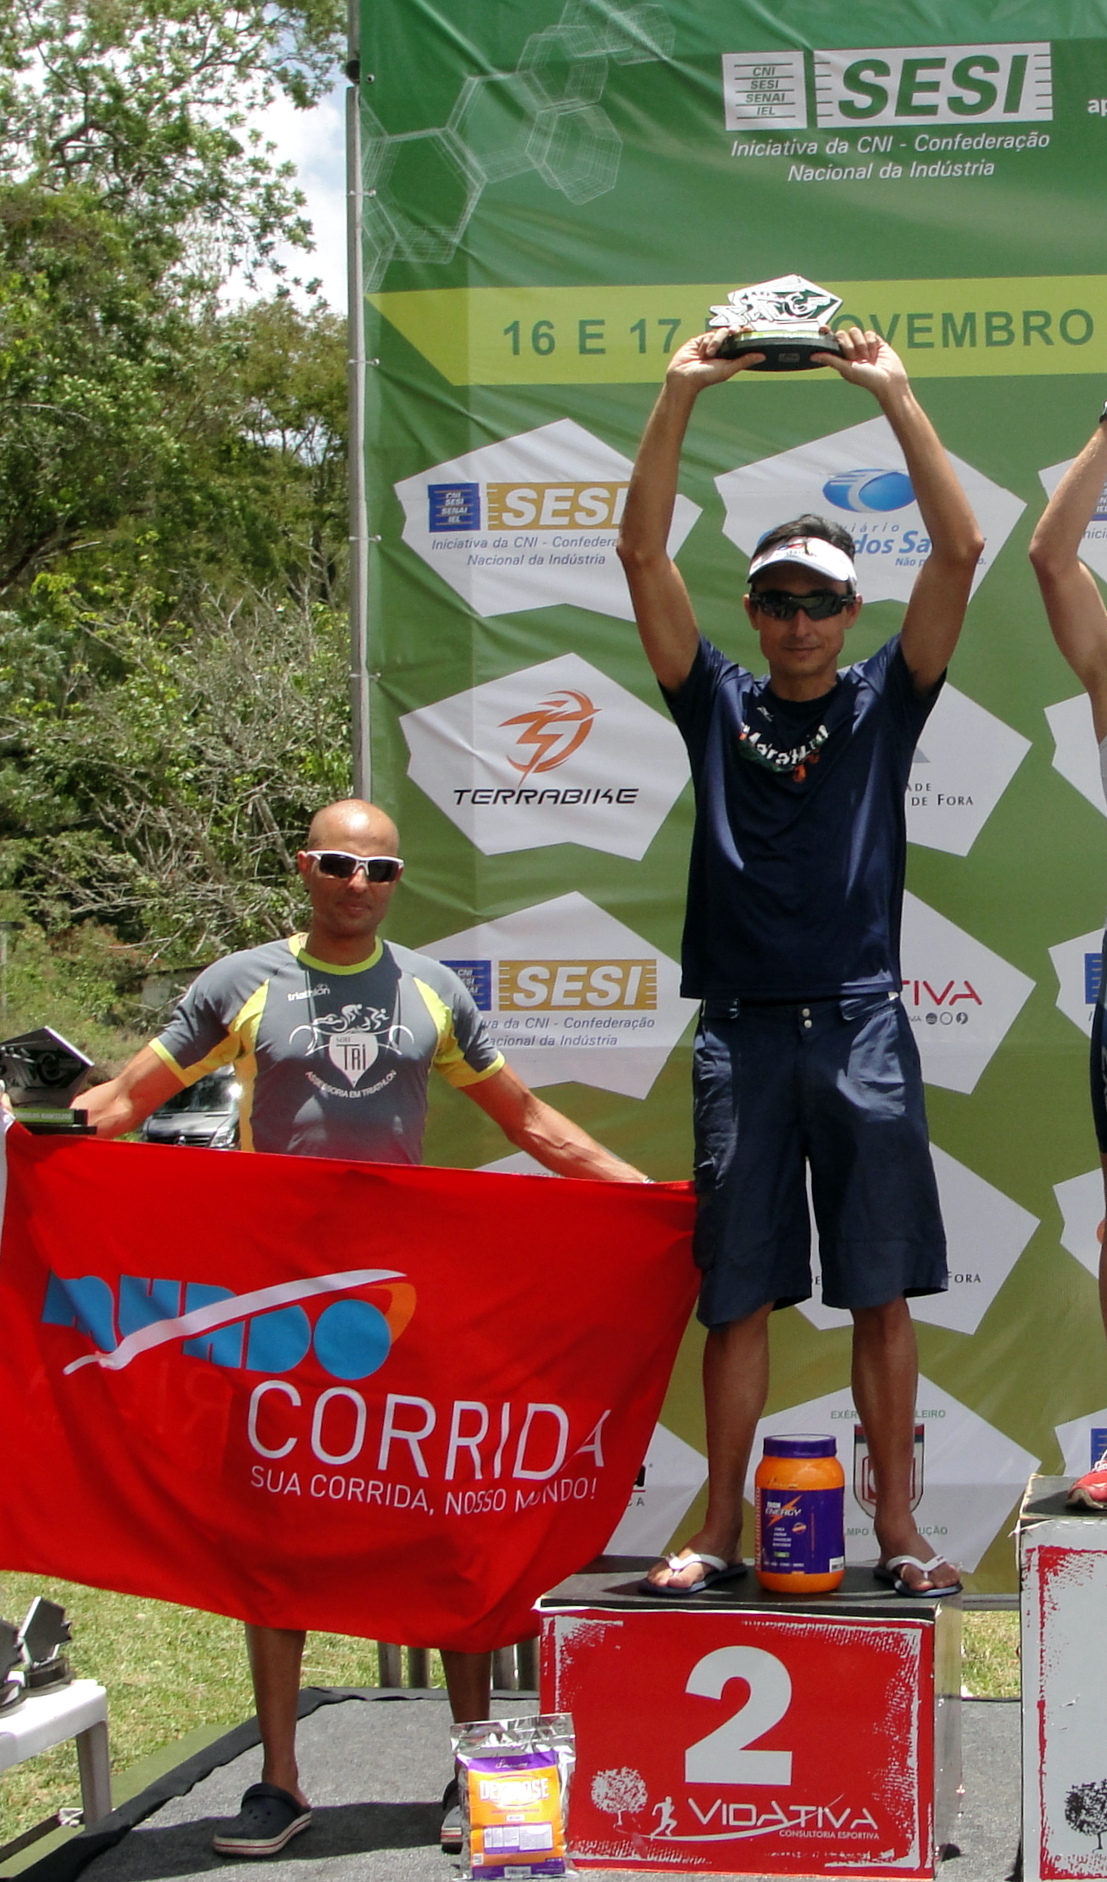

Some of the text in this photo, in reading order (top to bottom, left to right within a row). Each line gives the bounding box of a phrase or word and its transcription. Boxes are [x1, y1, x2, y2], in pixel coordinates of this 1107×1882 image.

[752, 66, 775, 77] CNI
[750, 79, 779, 90] SESI
[838, 54, 1029, 120] SESI
[745, 92, 786, 103] SENAI
[756, 105, 776, 116] IEL
[731, 137, 818, 157] Iniciativa
[825, 137, 849, 154] da
[857, 135, 893, 153] CNI
[914, 132, 1050, 155] Confederação
[788, 158, 995, 181] Nacional da Indústria
[503, 319, 556, 358] 16
[578, 319, 605, 356] E
[629, 316, 681, 355] 17
[831, 307, 1094, 352] OVEMBRO
[431, 536, 619, 550] Iniciativa da CNI Confedera
[467, 552, 606, 566] Nacional da Indústria
[453, 788, 640, 805] TERRABIKE
[911, 793, 974, 807] DE FORA
[513, 966, 643, 1007] SESI
[503, 1017, 519, 1029] da
[525, 1017, 550, 1028] CNI
[563, 1016, 655, 1030] Confederação
[490, 1034, 618, 1047] acional da Indústria
[247, 1379, 611, 1481] CORRIDA
[250, 1465, 301, 1496] SUA
[310, 1473, 434, 1516] CORRIDA,
[445, 1488, 507, 1515] NOSSO
[685, 1645, 793, 1786] 2
[687, 1797, 879, 1831] VIDATIVA
[779, 1829, 880, 1840] CONSULTORIA ESPORTIVA
